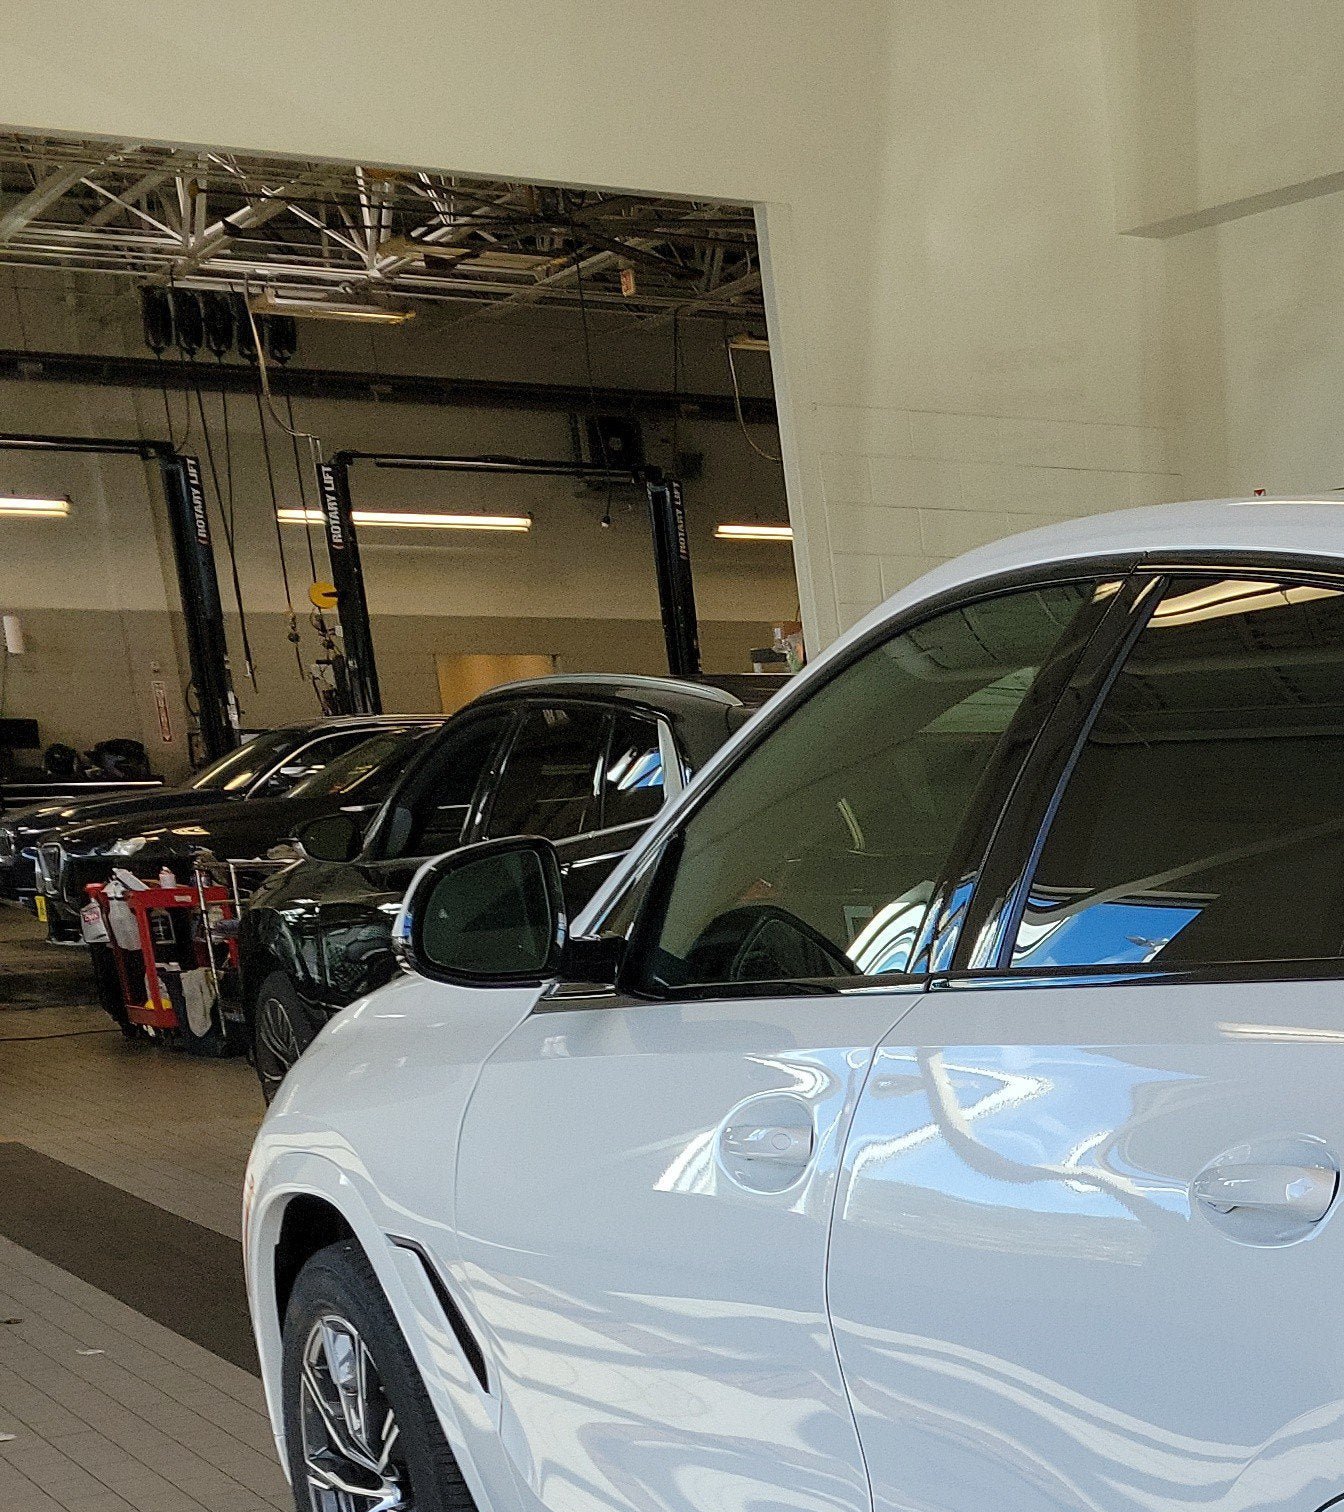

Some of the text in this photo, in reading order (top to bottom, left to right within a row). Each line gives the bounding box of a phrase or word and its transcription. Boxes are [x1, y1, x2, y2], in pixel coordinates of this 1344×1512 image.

[186, 457, 207, 538] ROTARY LIFT
[322, 466, 343, 543] ROTARY LIFT
